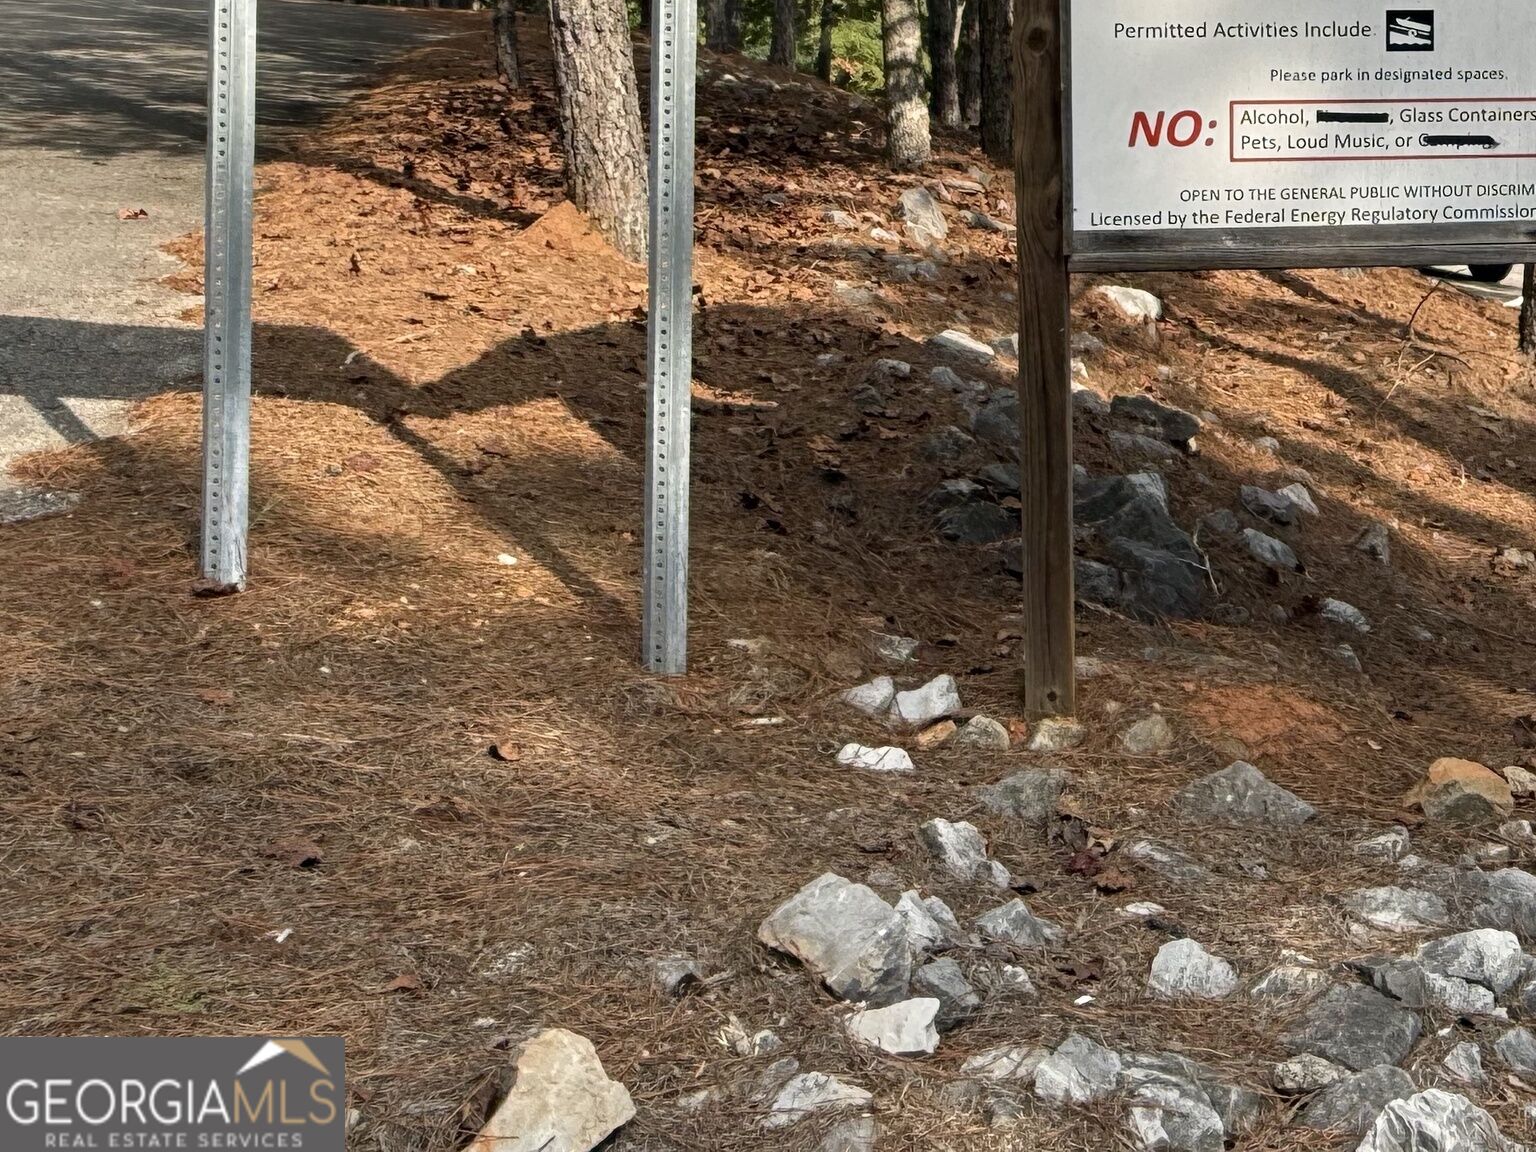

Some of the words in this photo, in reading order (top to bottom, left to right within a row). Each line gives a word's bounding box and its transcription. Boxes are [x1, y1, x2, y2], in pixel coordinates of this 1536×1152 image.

[1115, 22, 1206, 38] Permitted
[1214, 22, 1297, 37] Activities
[1271, 69, 1315, 81] Please
[1322, 68, 1352, 83] park
[1358, 69, 1369, 80] in
[1375, 67, 1452, 83] designated
[1458, 70, 1507, 82] spaces.
[1241, 109, 1308, 126] Alcohol,
[1400, 108, 1443, 122] Glass
[1449, 108, 1536, 122] Containers
[1128, 110, 1217, 147] NO:
[1242, 136, 1280, 152] Pets,
[1288, 134, 1328, 149] Loud
[1335, 134, 1388, 150] Music,
[1395, 137, 1412, 147] or
[1180, 190, 1219, 202] OPEN
[1225, 189, 1243, 200] TO
[1249, 189, 1275, 200] THE
[1281, 187, 1346, 200] GENERAL
[1351, 186, 1399, 198] PUBLIC
[1404, 185, 1472, 198] WITHOUT
[1090, 209, 1162, 227] Licensed
[1167, 209, 1187, 230] by
[1191, 208, 1221, 226] the
[1225, 207, 1287, 225] Federal
[1291, 206, 1347, 228] Energy
[1351, 203, 1439, 226] Regulatory
